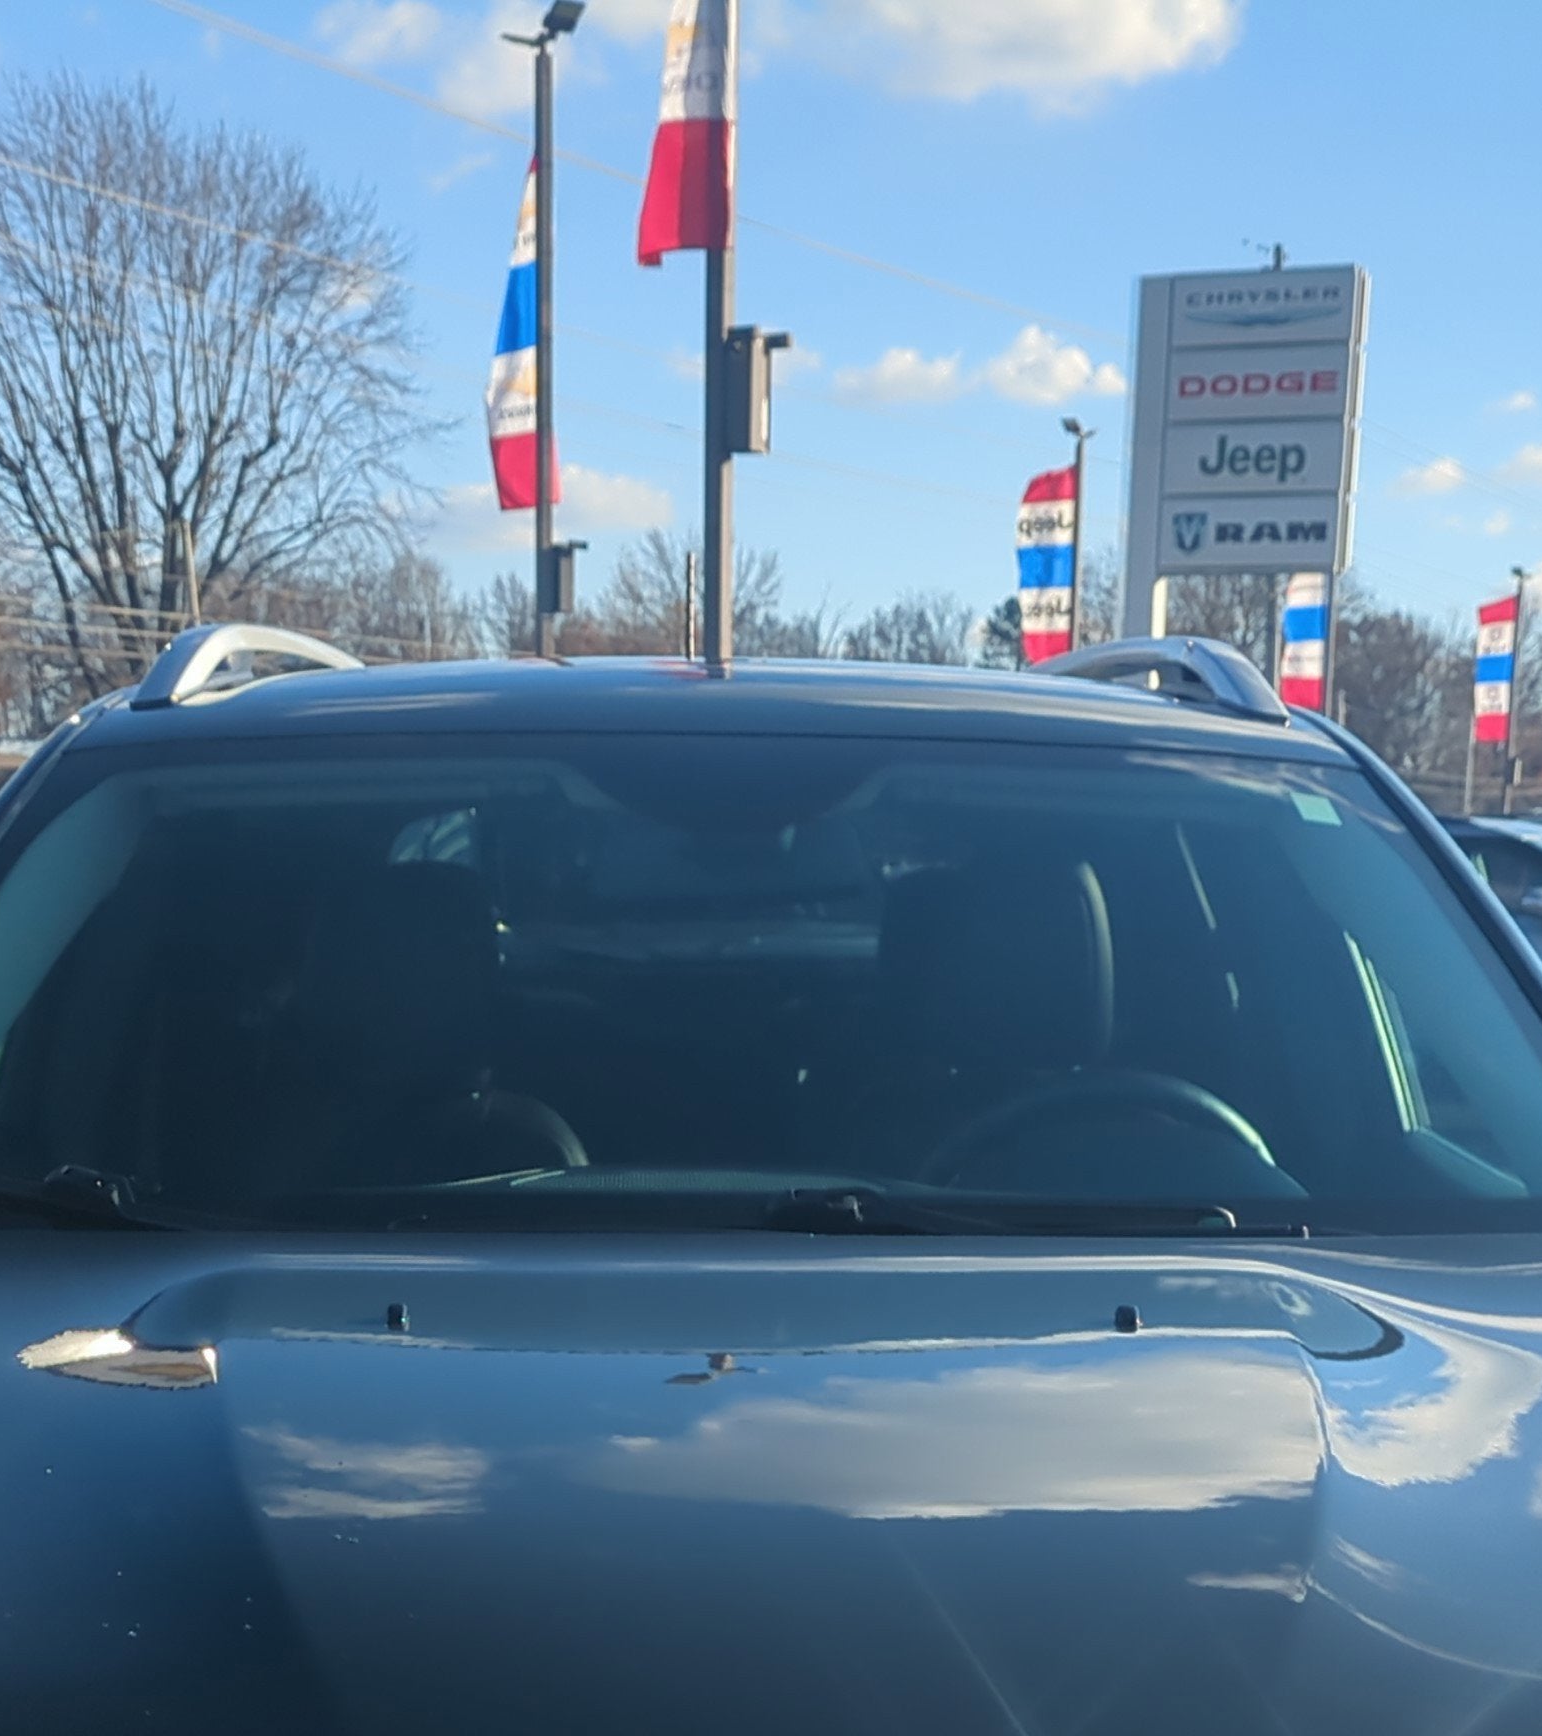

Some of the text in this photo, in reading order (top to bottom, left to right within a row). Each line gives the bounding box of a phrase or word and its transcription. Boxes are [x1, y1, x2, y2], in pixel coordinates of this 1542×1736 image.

[1186, 285, 1341, 307] CHRYSLER
[1178, 370, 1340, 398] DODGE
[1199, 434, 1306, 482] Jeep
[1215, 521, 1327, 544] RAM
